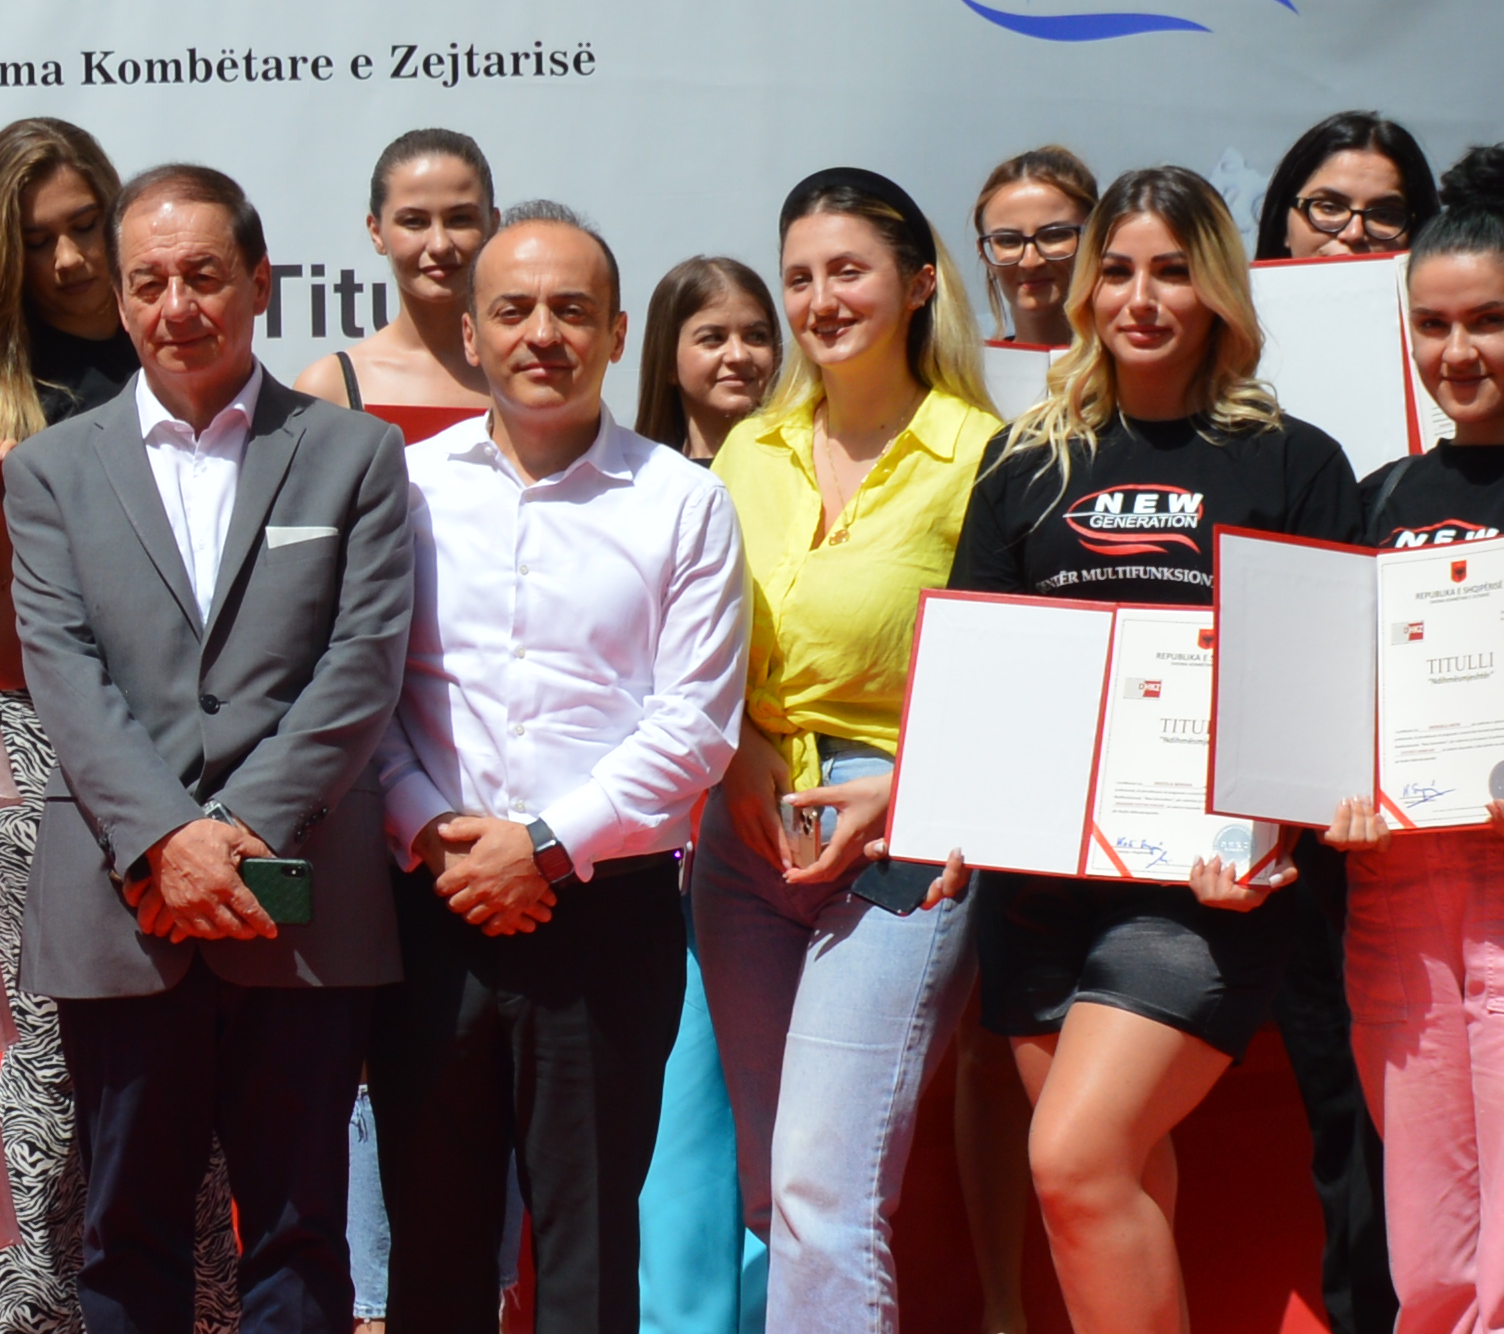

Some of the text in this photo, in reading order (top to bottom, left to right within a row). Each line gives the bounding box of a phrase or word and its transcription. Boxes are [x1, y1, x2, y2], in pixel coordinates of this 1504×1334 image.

[80, 46, 334, 87] Kombëtare
[349, 56, 374, 81] e
[390, 41, 597, 88] Zejtarisë
[1094, 492, 1204, 514] NEW
[1088, 514, 1199, 529] GENERATION
[1081, 565, 1214, 589] MULTIFUNKSION
[1415, 589, 1455, 601] REPUBLIKA
[1156, 652, 1201, 662] REPUBLIKA
[1426, 651, 1495, 676] TITULLI
[1160, 717, 1212, 735] TITU
